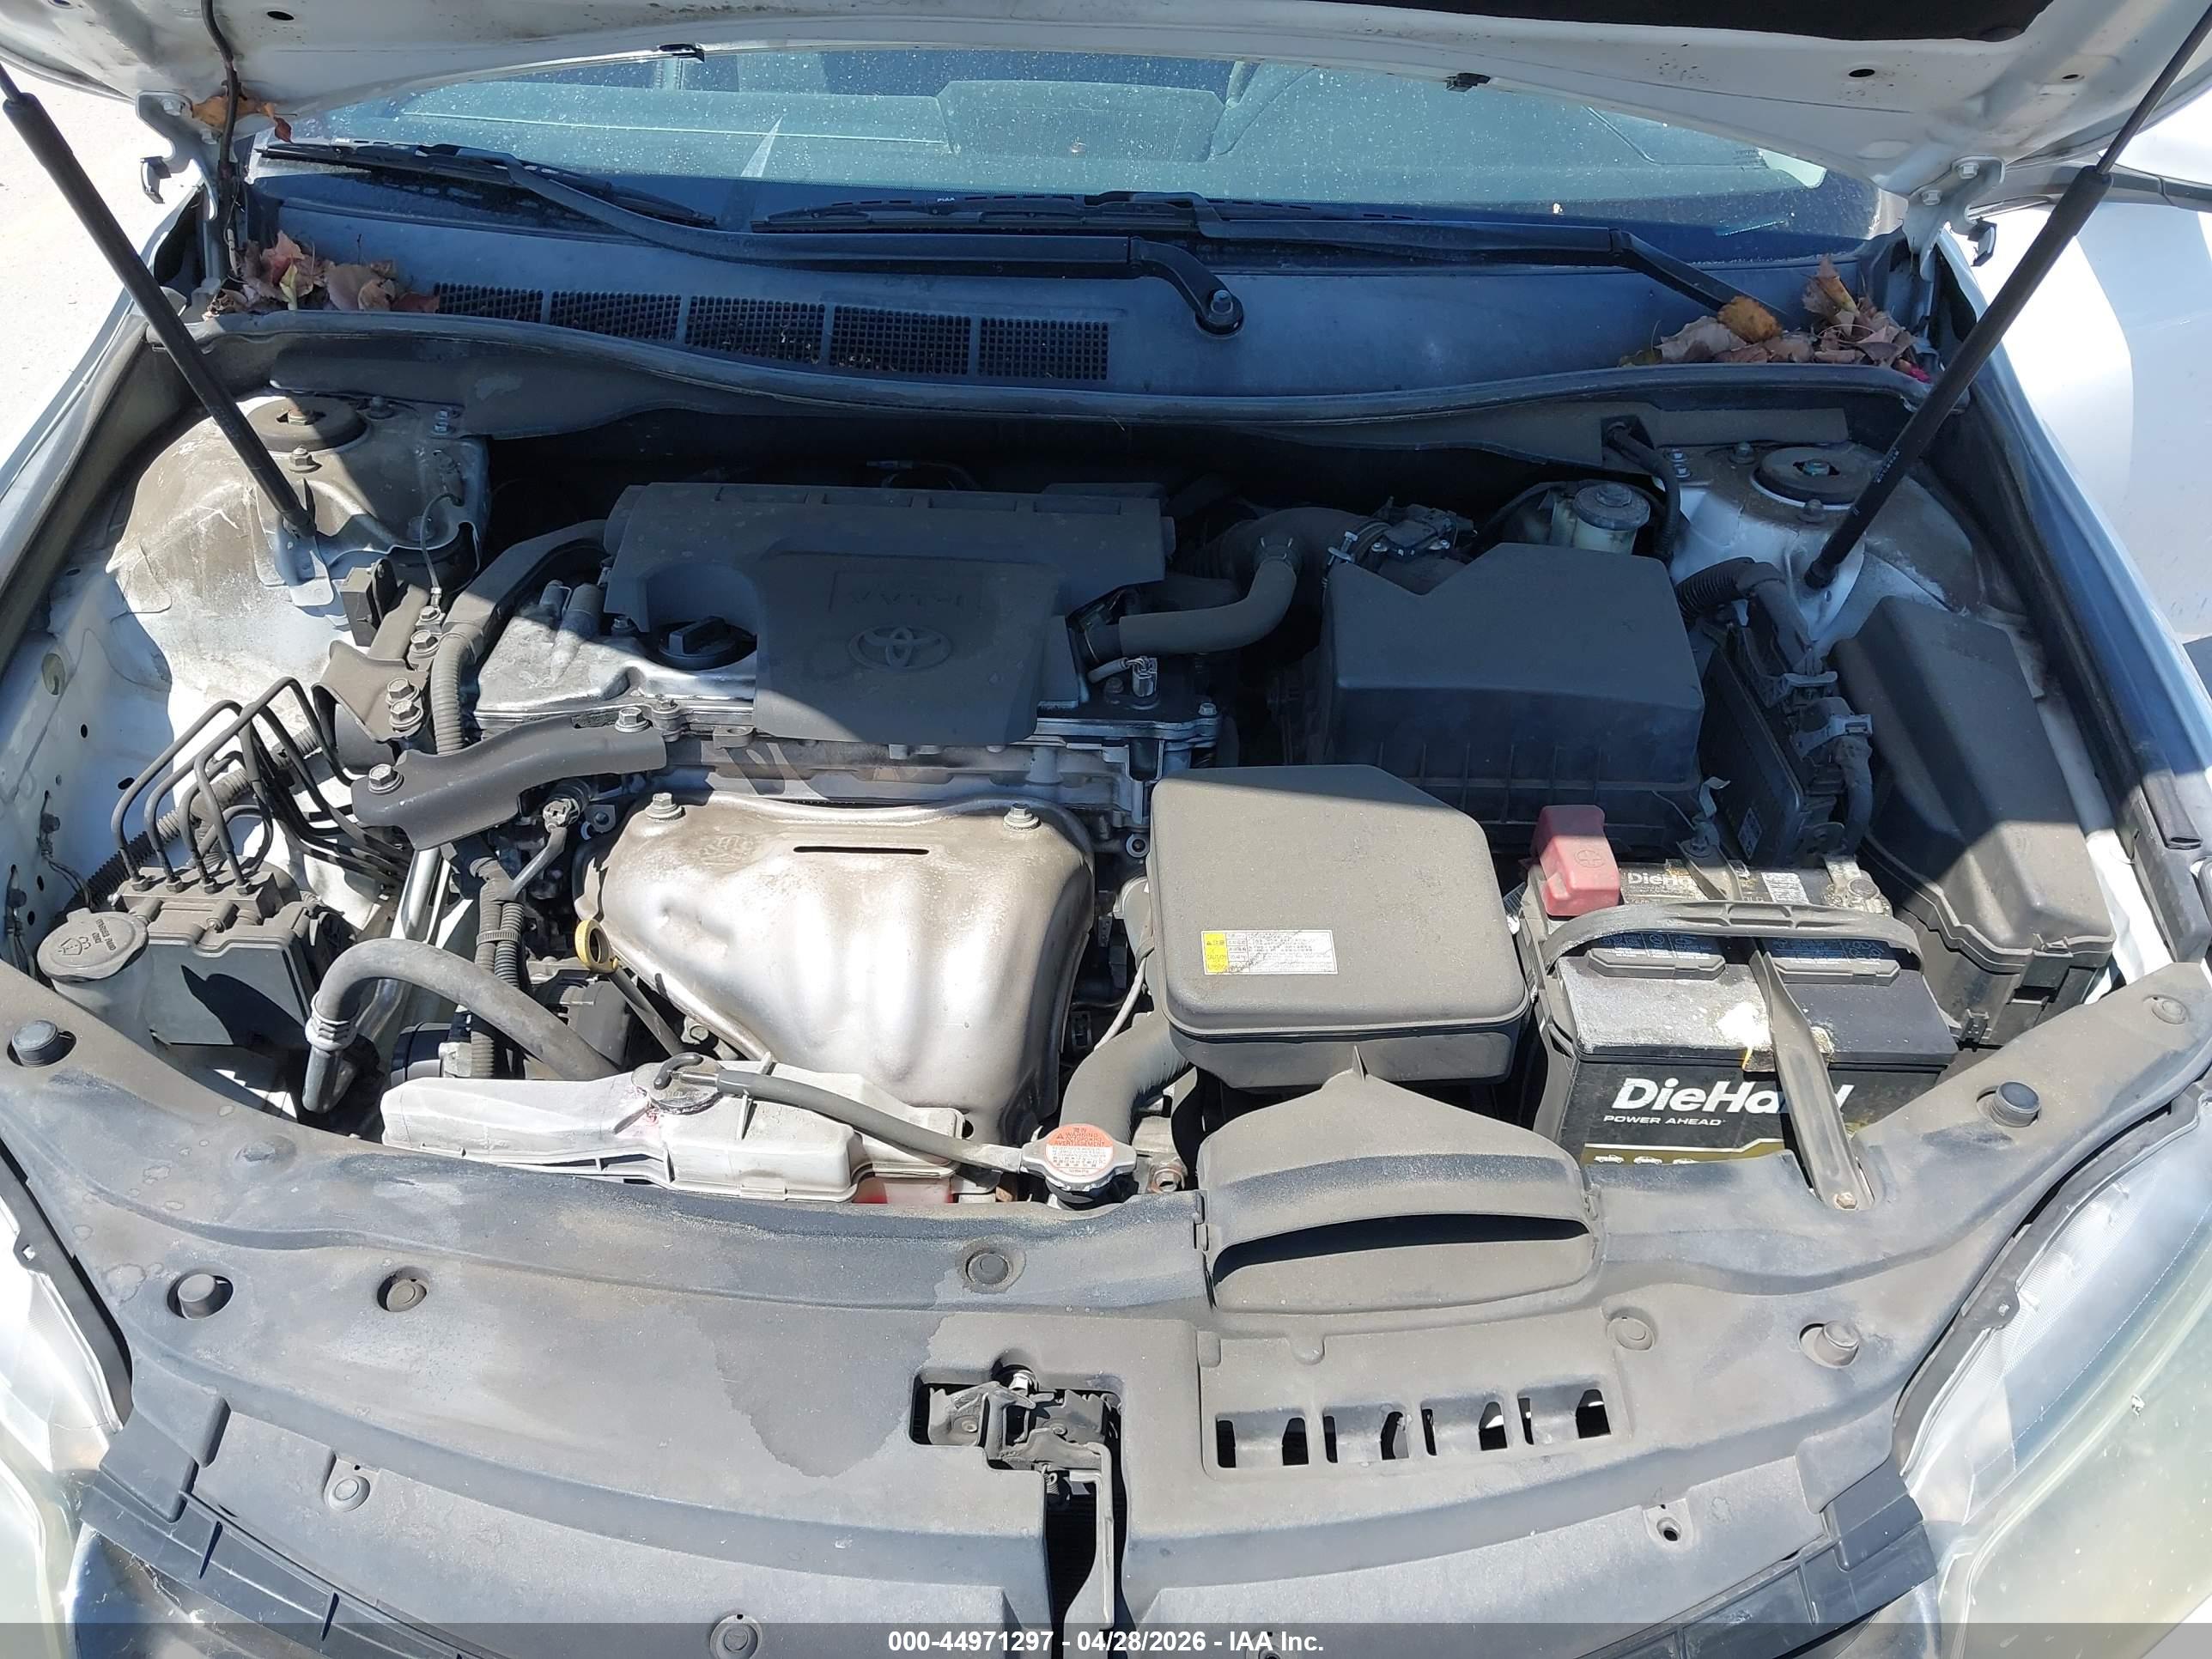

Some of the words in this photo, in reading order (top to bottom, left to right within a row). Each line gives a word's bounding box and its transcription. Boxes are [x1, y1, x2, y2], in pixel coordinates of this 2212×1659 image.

[1612, 1077, 1855, 1115] DieHa
[1603, 1115, 1661, 1124] POWER
[1665, 1117, 1723, 1126] AHEAD
